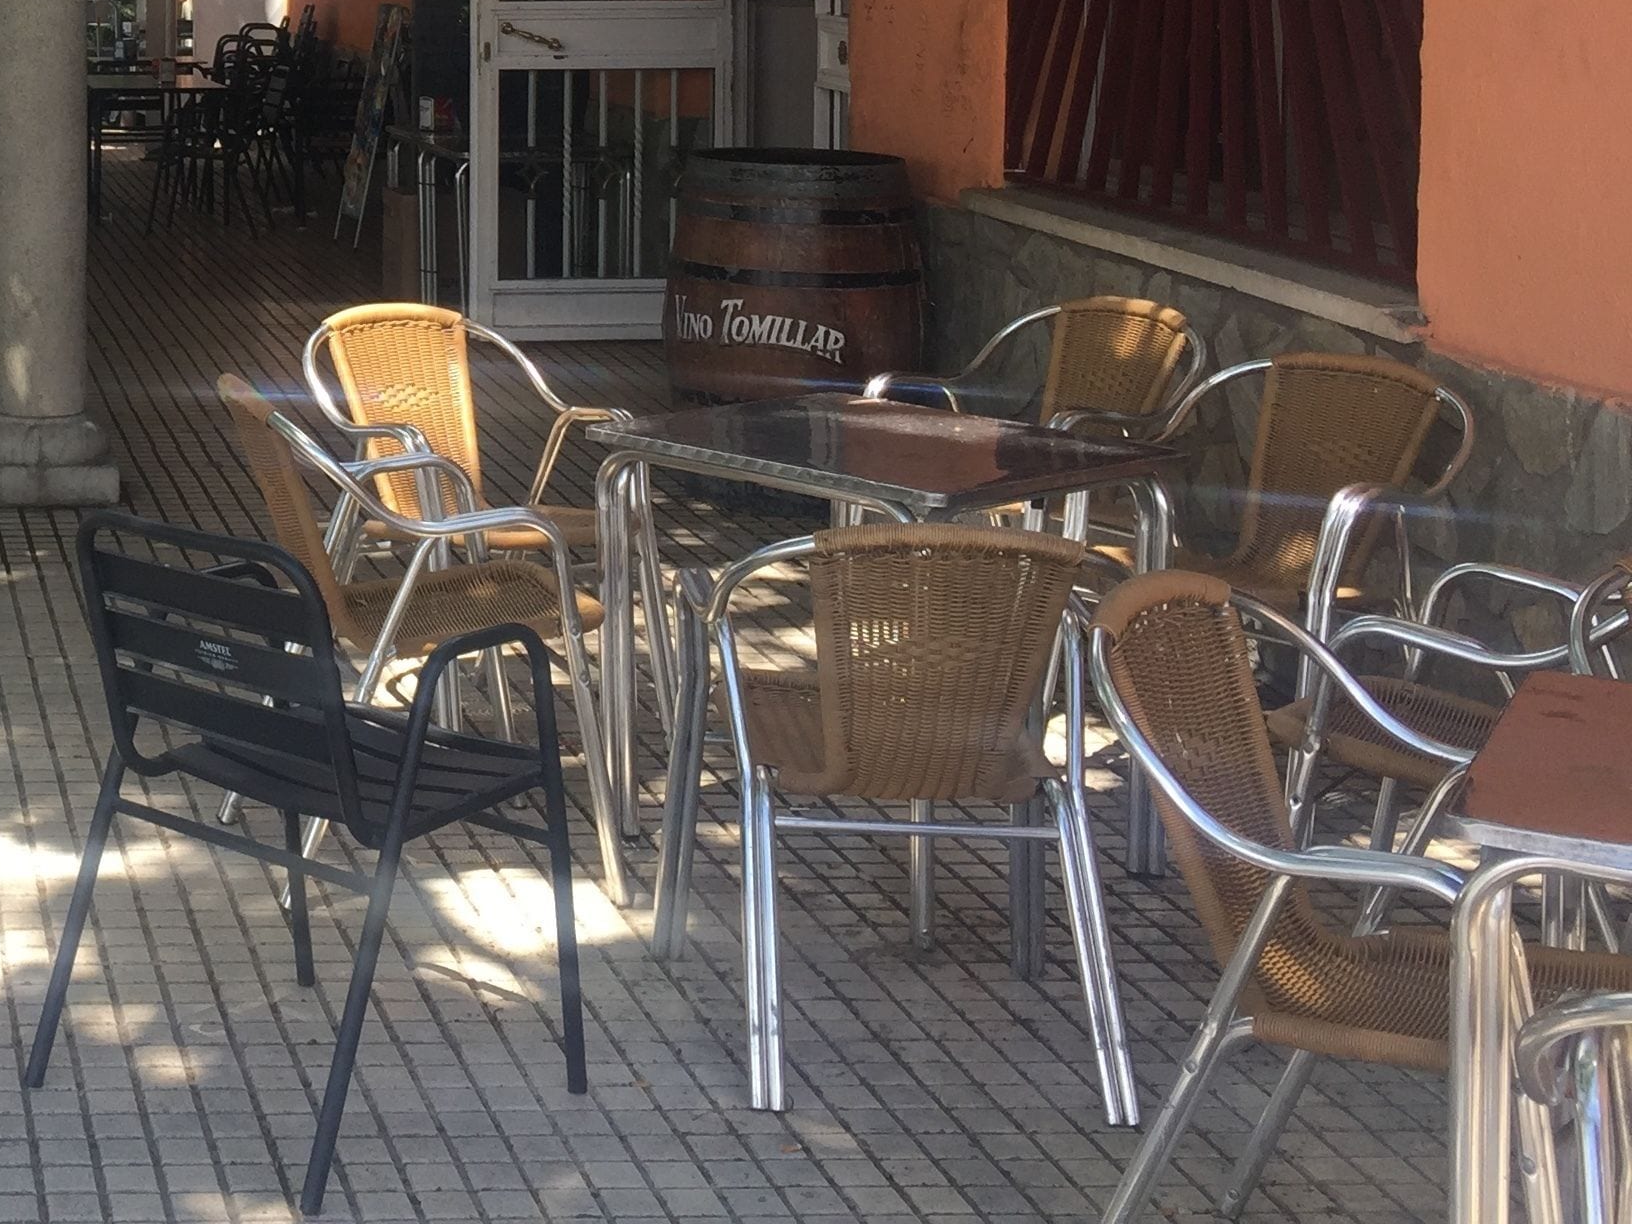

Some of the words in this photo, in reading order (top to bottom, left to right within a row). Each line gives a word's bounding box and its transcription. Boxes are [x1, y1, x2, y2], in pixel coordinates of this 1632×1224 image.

[675, 294, 713, 340] VINO
[720, 298, 846, 365] TOMILLAR
[199, 639, 232, 657] AMSTEL
